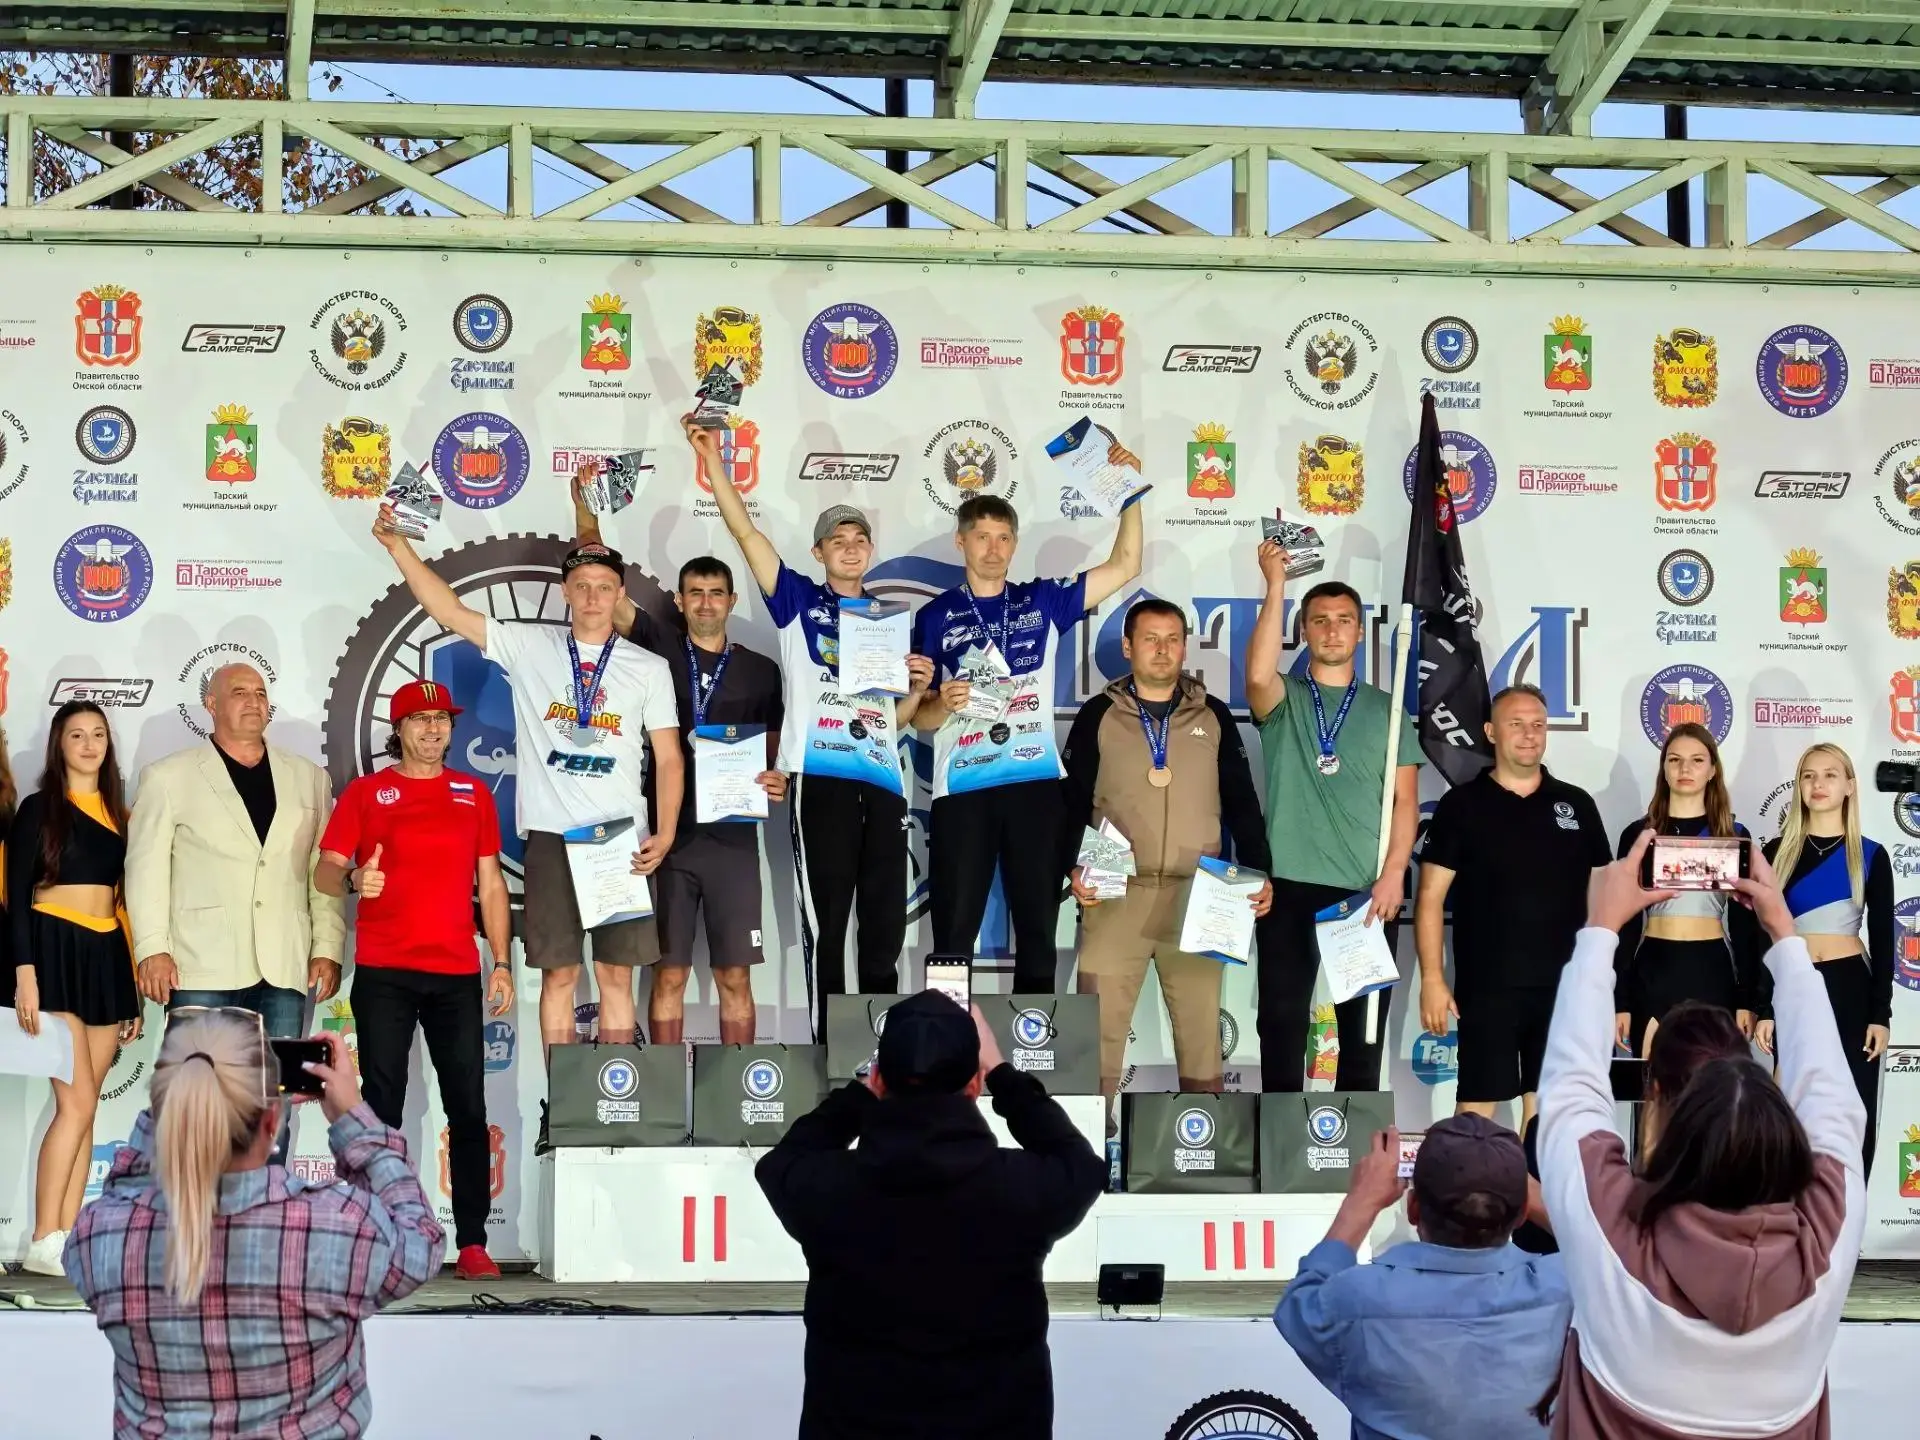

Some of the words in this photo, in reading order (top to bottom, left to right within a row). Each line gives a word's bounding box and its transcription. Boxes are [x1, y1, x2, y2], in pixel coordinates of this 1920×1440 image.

[309, 290, 379, 330] МИНИСТЕРСТВО
[379, 297, 408, 332] СПОРТА
[808, 304, 879, 336] МОТОЦИКЛЕТНОГО
[878, 319, 897, 351] СПОРТА
[1284, 312, 1350, 351] МИНИСТЕРСТВО
[1350, 317, 1379, 353] СПОРТА
[205, 334, 275, 346] STORK
[1762, 325, 1829, 357] МОТОЦИКЛЕТНОГО
[198, 345, 256, 353] CAMPER
[940, 342, 990, 355] Тарское
[939, 352, 1023, 366] Прииртышье
[1185, 356, 1249, 367] STORK
[1829, 340, 1847, 372] СПОРТА
[308, 349, 361, 391] РОССИЙСКОЙ
[363, 351, 408, 391] ФЕДЕРАЦИИ
[877, 353, 898, 386] РОССИИ
[1178, 366, 1233, 374] CAMPER
[75, 371, 140, 381] Правительство
[72, 381, 105, 391] Омской
[107, 382, 142, 391] области
[588, 379, 623, 389] Тарский
[1284, 368, 1335, 411] РОССИЙСКОЙ
[1336, 371, 1379, 410] ФЕДЕРАЦИИ
[1827, 374, 1847, 406] РОССИИ
[558, 389, 625, 400] муниципальный
[627, 390, 651, 400] округ
[834, 385, 866, 398] MFR
[1060, 390, 1123, 401] Правительство
[1058, 400, 1089, 410] Омской
[1091, 401, 1125, 410] области
[1552, 400, 1584, 409] Тарский
[1788, 405, 1818, 416] MFR
[1523, 409, 1588, 420] муниципальный
[1589, 411, 1613, 420] округ
[1, 409, 30, 444] СПОРТА
[439, 414, 510, 446] МОТОЦИКЛЕТНОГО
[510, 429, 528, 464] СПОРТА
[923, 420, 990, 460] МИНИСТЕРСТВО
[990, 425, 1019, 461] СПОРТА
[1477, 446, 1495, 478] СПОРТА
[822, 463, 890, 475] STORK
[507, 463, 528, 496] РОССИИ
[814, 473, 870, 481] CAMPER
[1535, 470, 1586, 482] Тарское
[1535, 480, 1618, 494] Прииртышье
[1776, 481, 1839, 492] STORK
[213, 492, 248, 501] Тарский
[1475, 481, 1495, 513] РОССИИ
[1770, 490, 1823, 499] CAMPER
[182, 502, 251, 511] муниципальный
[253, 503, 278, 512] округ
[465, 497, 496, 507] MFR
[1194, 508, 1227, 517] Тарский
[1165, 518, 1231, 528] муниципальный
[1233, 519, 1256, 527] округ
[1655, 516, 1716, 526] Правительство
[1653, 525, 1684, 535] Омской
[1686, 526, 1719, 536] области
[59, 526, 133, 559] МОТОЦИКЛЕТНОГО
[133, 541, 151, 573] СПОРТА
[195, 564, 249, 577] Тарское
[195, 575, 282, 588] Прииртышье
[130, 576, 151, 609] РОССИИ
[87, 609, 119, 621] MFR
[1787, 633, 1820, 641] Тарский
[1759, 642, 1822, 652] муниципальный
[1824, 643, 1848, 652] округ
[178, 642, 248, 683] МИНИСТЕРСТВО
[248, 650, 277, 685] СПОРТА
[1645, 665, 1713, 697] МОТОЦИКЛЕТНОГО
[1714, 680, 1730, 711] СПОРТА
[73, 689, 143, 700] STORK
[1772, 703, 1822, 715] Тарское
[817, 717, 845, 729] MVP
[1772, 713, 1854, 727] Прииртышье
[958, 732, 984, 747] MVP
[100, 1060, 145, 1102] ФЕДЕРАЦИИ
